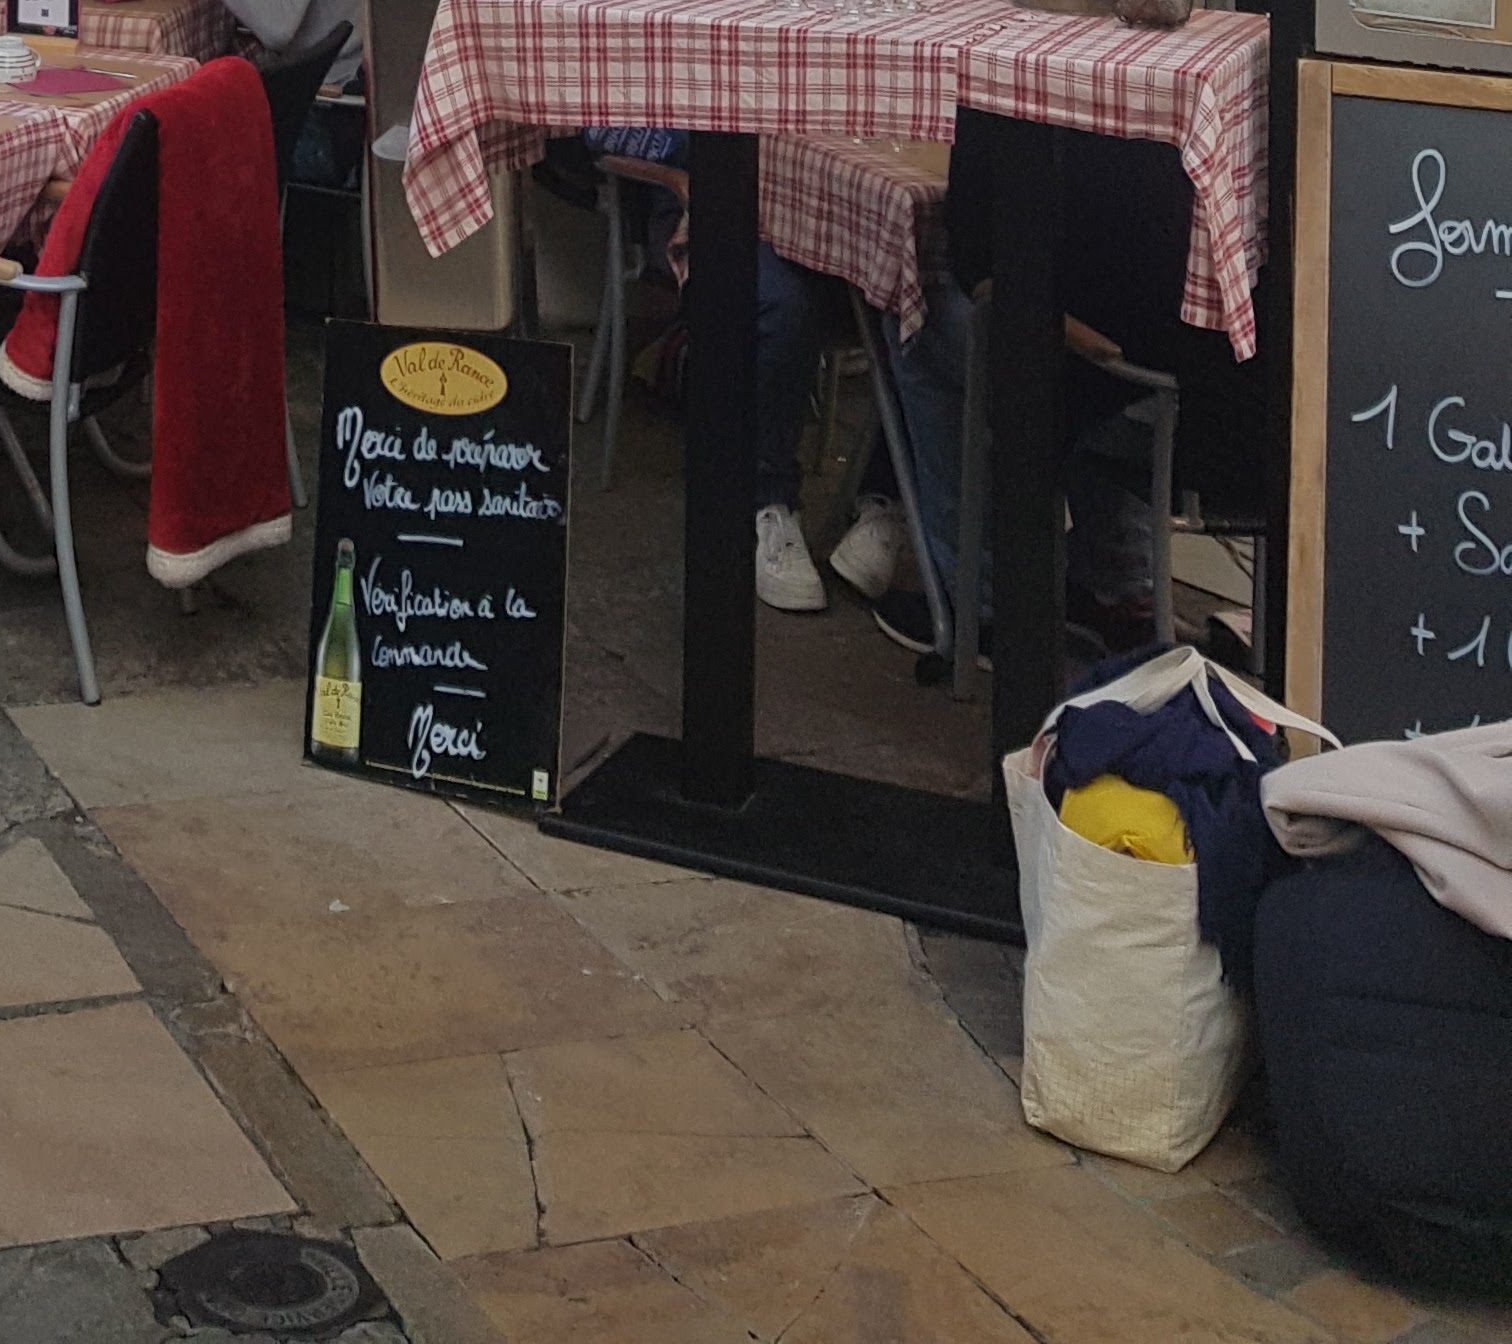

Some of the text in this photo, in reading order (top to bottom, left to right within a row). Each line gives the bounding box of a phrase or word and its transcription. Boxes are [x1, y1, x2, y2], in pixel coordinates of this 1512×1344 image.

[392, 346, 496, 389] Val de Rance
[1350, 382, 1399, 450] 1
[412, 425, 440, 462] de
[424, 486, 473, 522] pass
[505, 588, 537, 620] la
